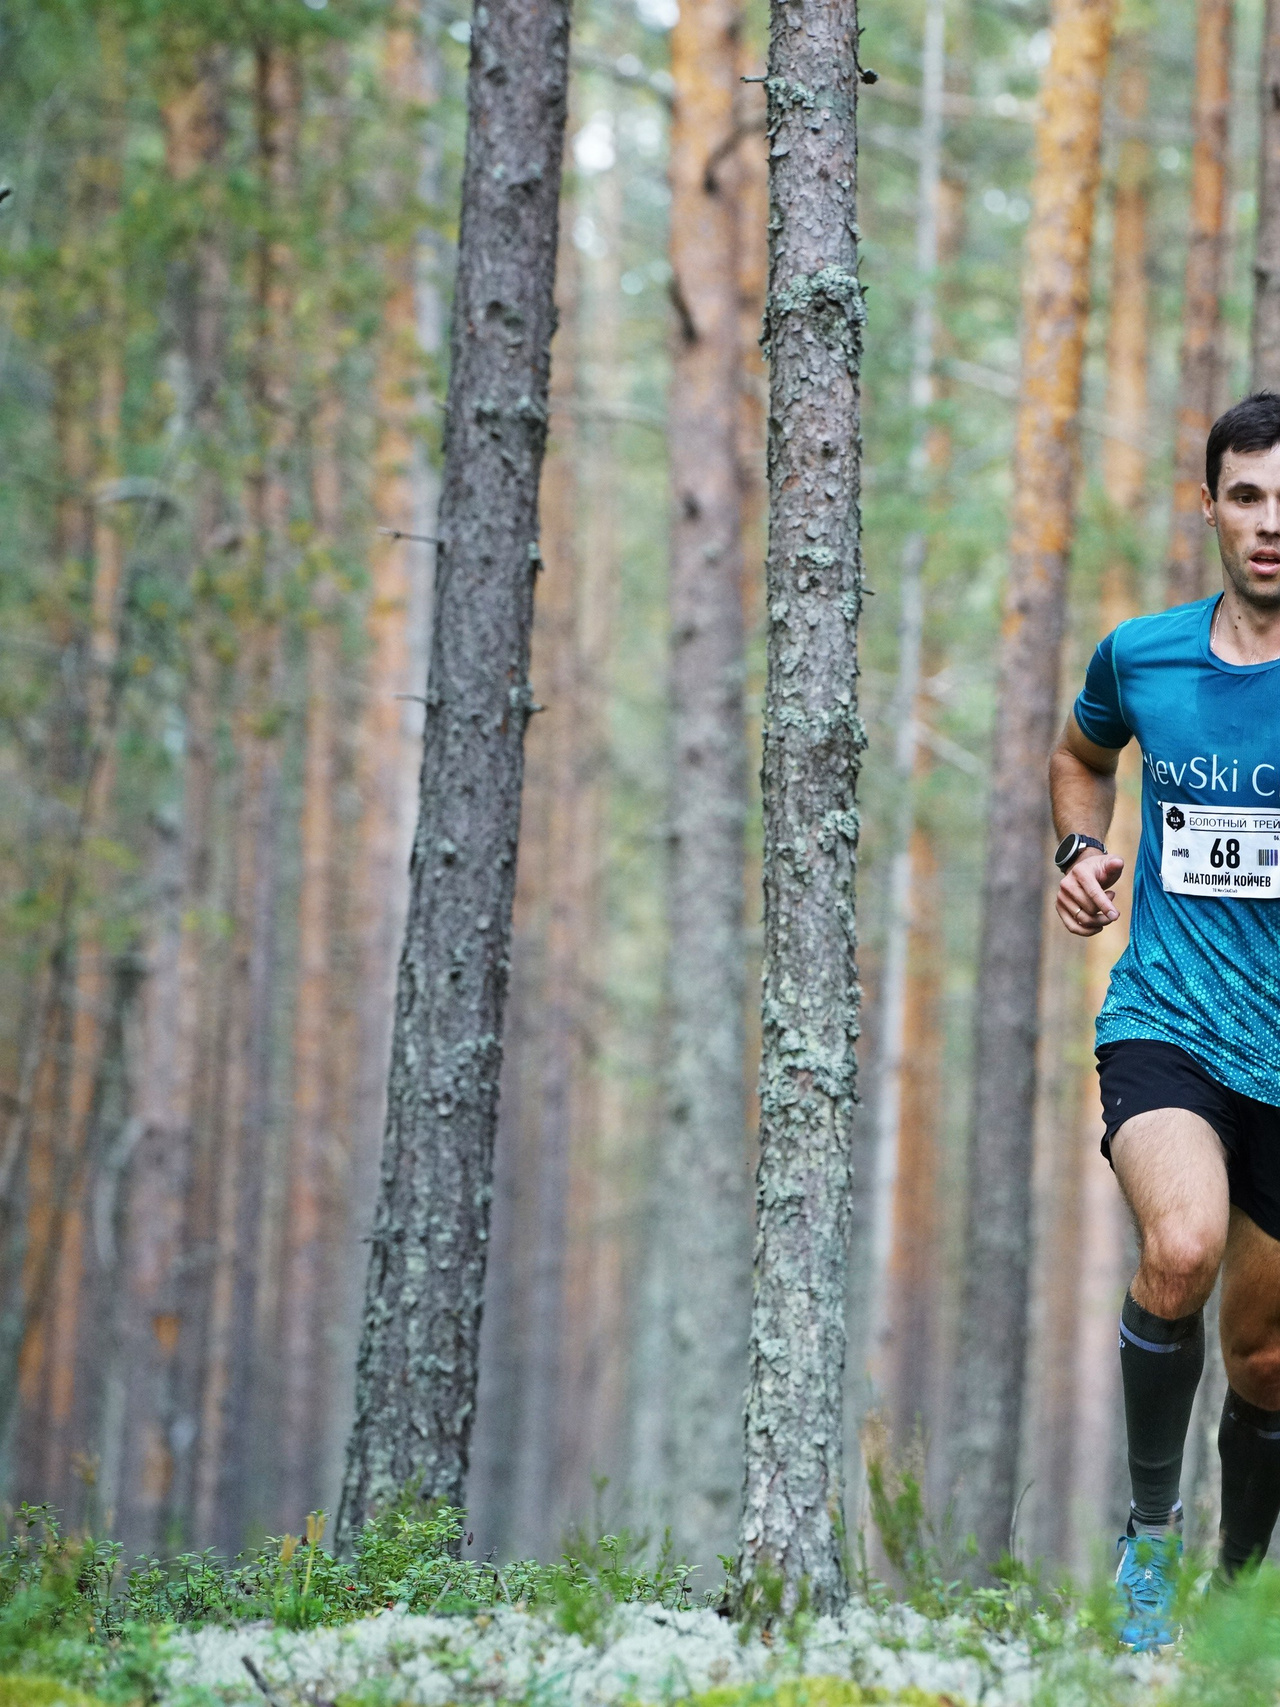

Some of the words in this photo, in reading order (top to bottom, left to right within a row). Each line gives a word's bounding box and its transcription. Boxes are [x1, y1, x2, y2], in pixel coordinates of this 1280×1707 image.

[1189, 816, 1247, 828] БОЛОТНЫЙ
[1210, 838, 1240, 869] 68
[1183, 871, 1231, 886] АНАТОЛИЙ
[1233, 872, 1271, 887] КОЙЧЕВ
